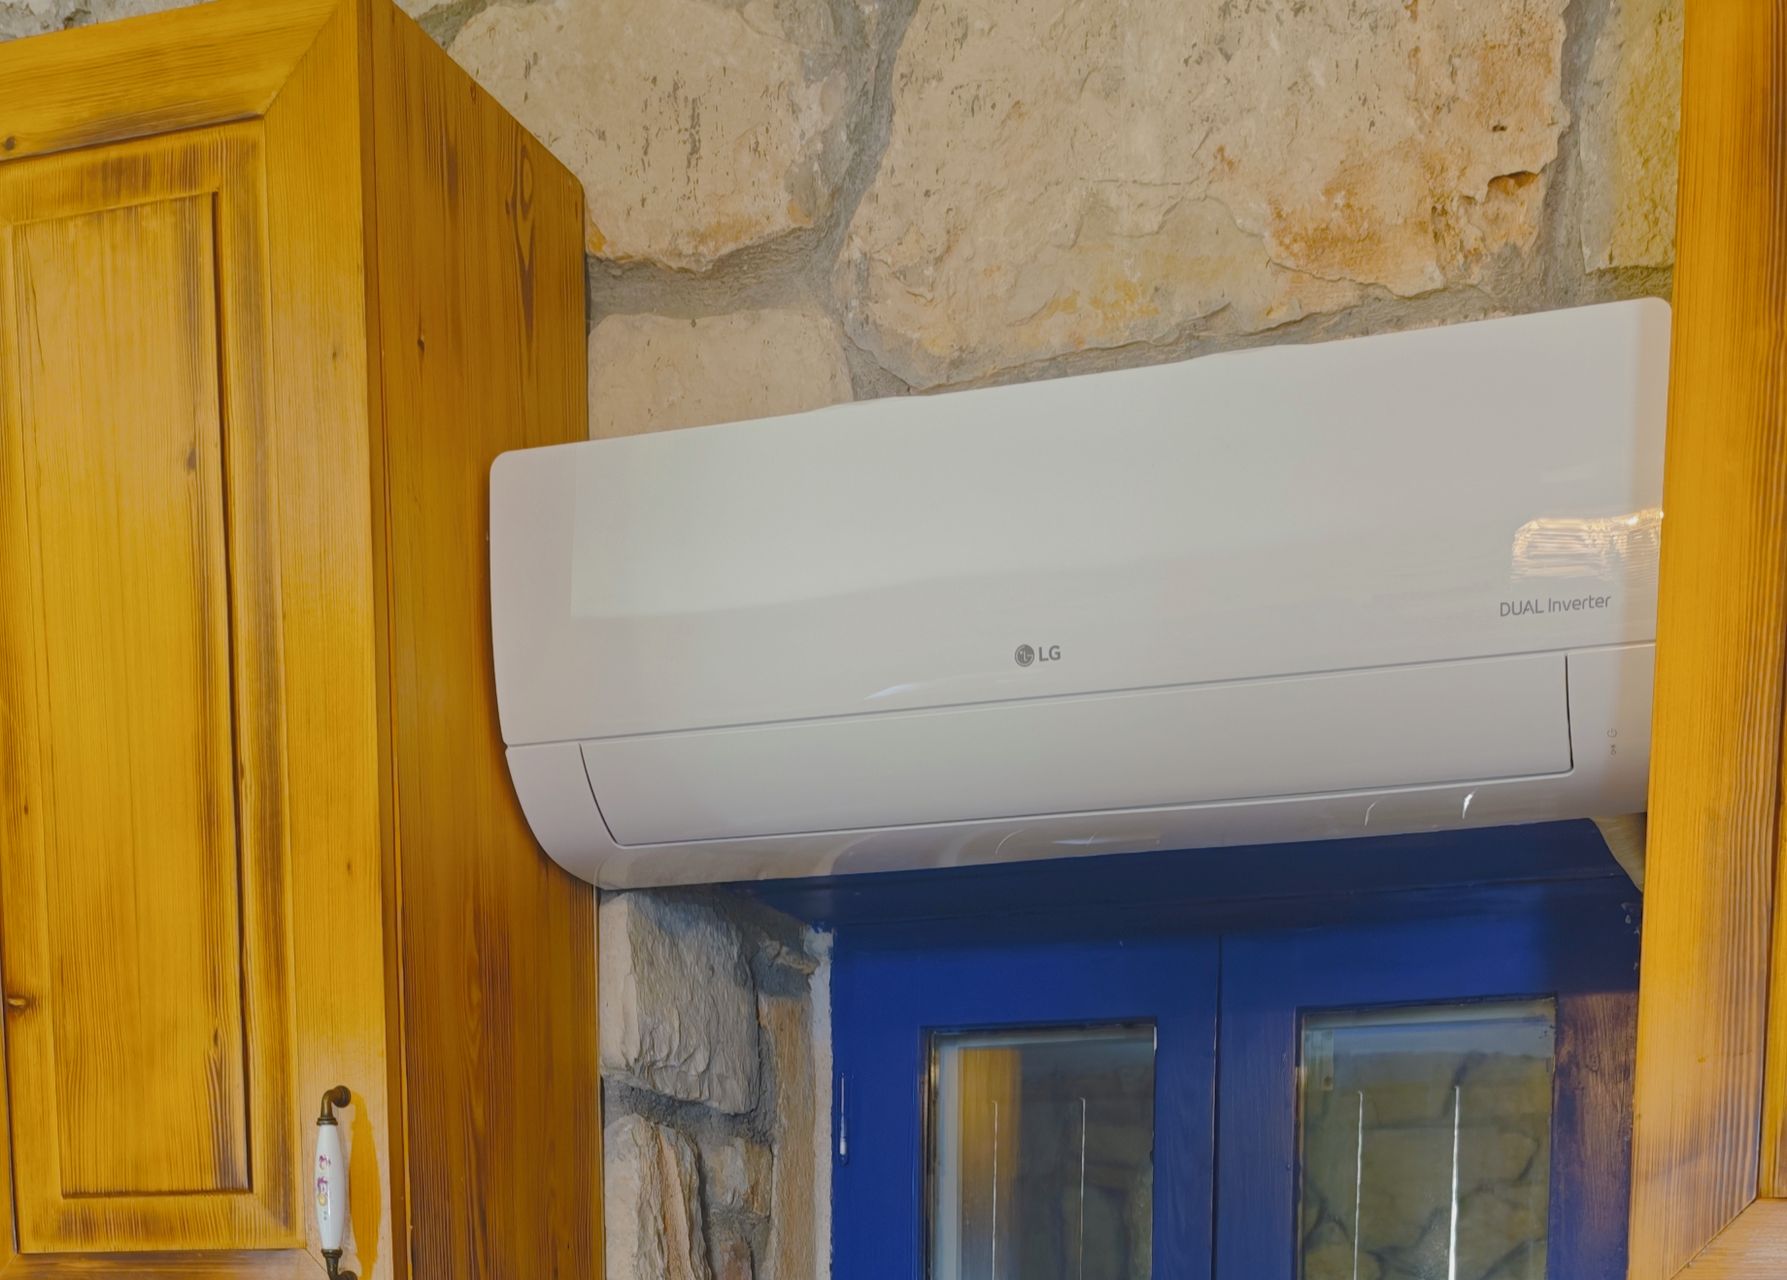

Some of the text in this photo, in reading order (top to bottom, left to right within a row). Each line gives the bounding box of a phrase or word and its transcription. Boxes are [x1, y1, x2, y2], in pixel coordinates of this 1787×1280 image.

[1500, 594, 1611, 617] DUAL Inverter
[1038, 645, 1061, 662] LG
